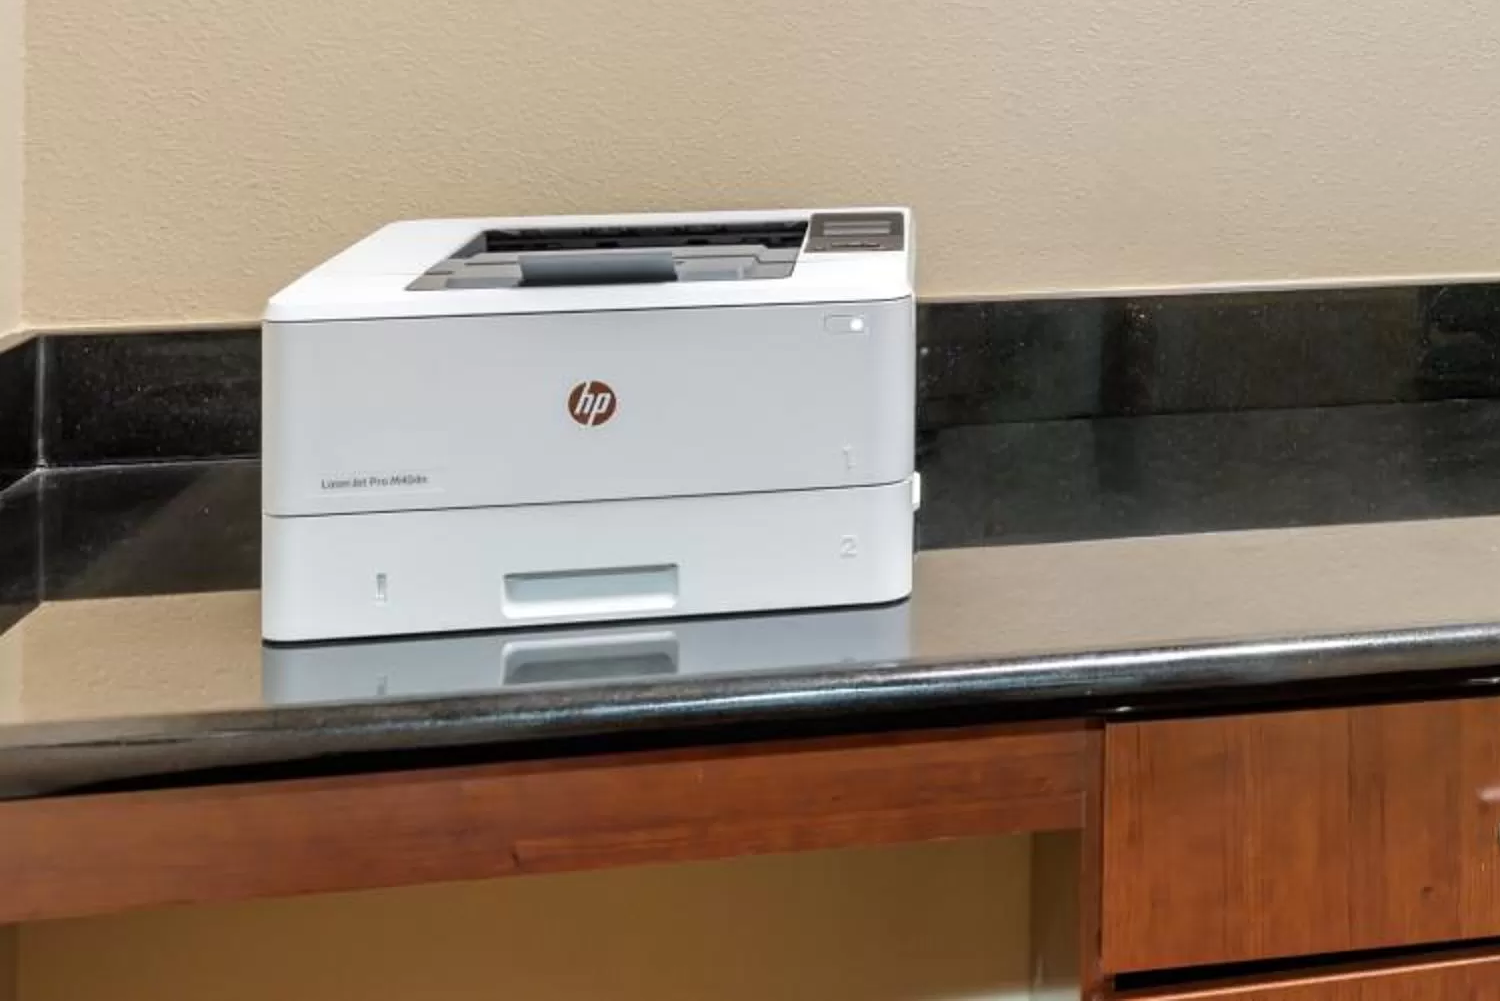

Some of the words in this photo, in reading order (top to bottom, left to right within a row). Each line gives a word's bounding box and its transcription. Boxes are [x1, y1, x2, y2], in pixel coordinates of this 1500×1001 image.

[570, 380, 615, 427] hp
[369, 476, 389, 488] Pro
[839, 533, 858, 560] 2
